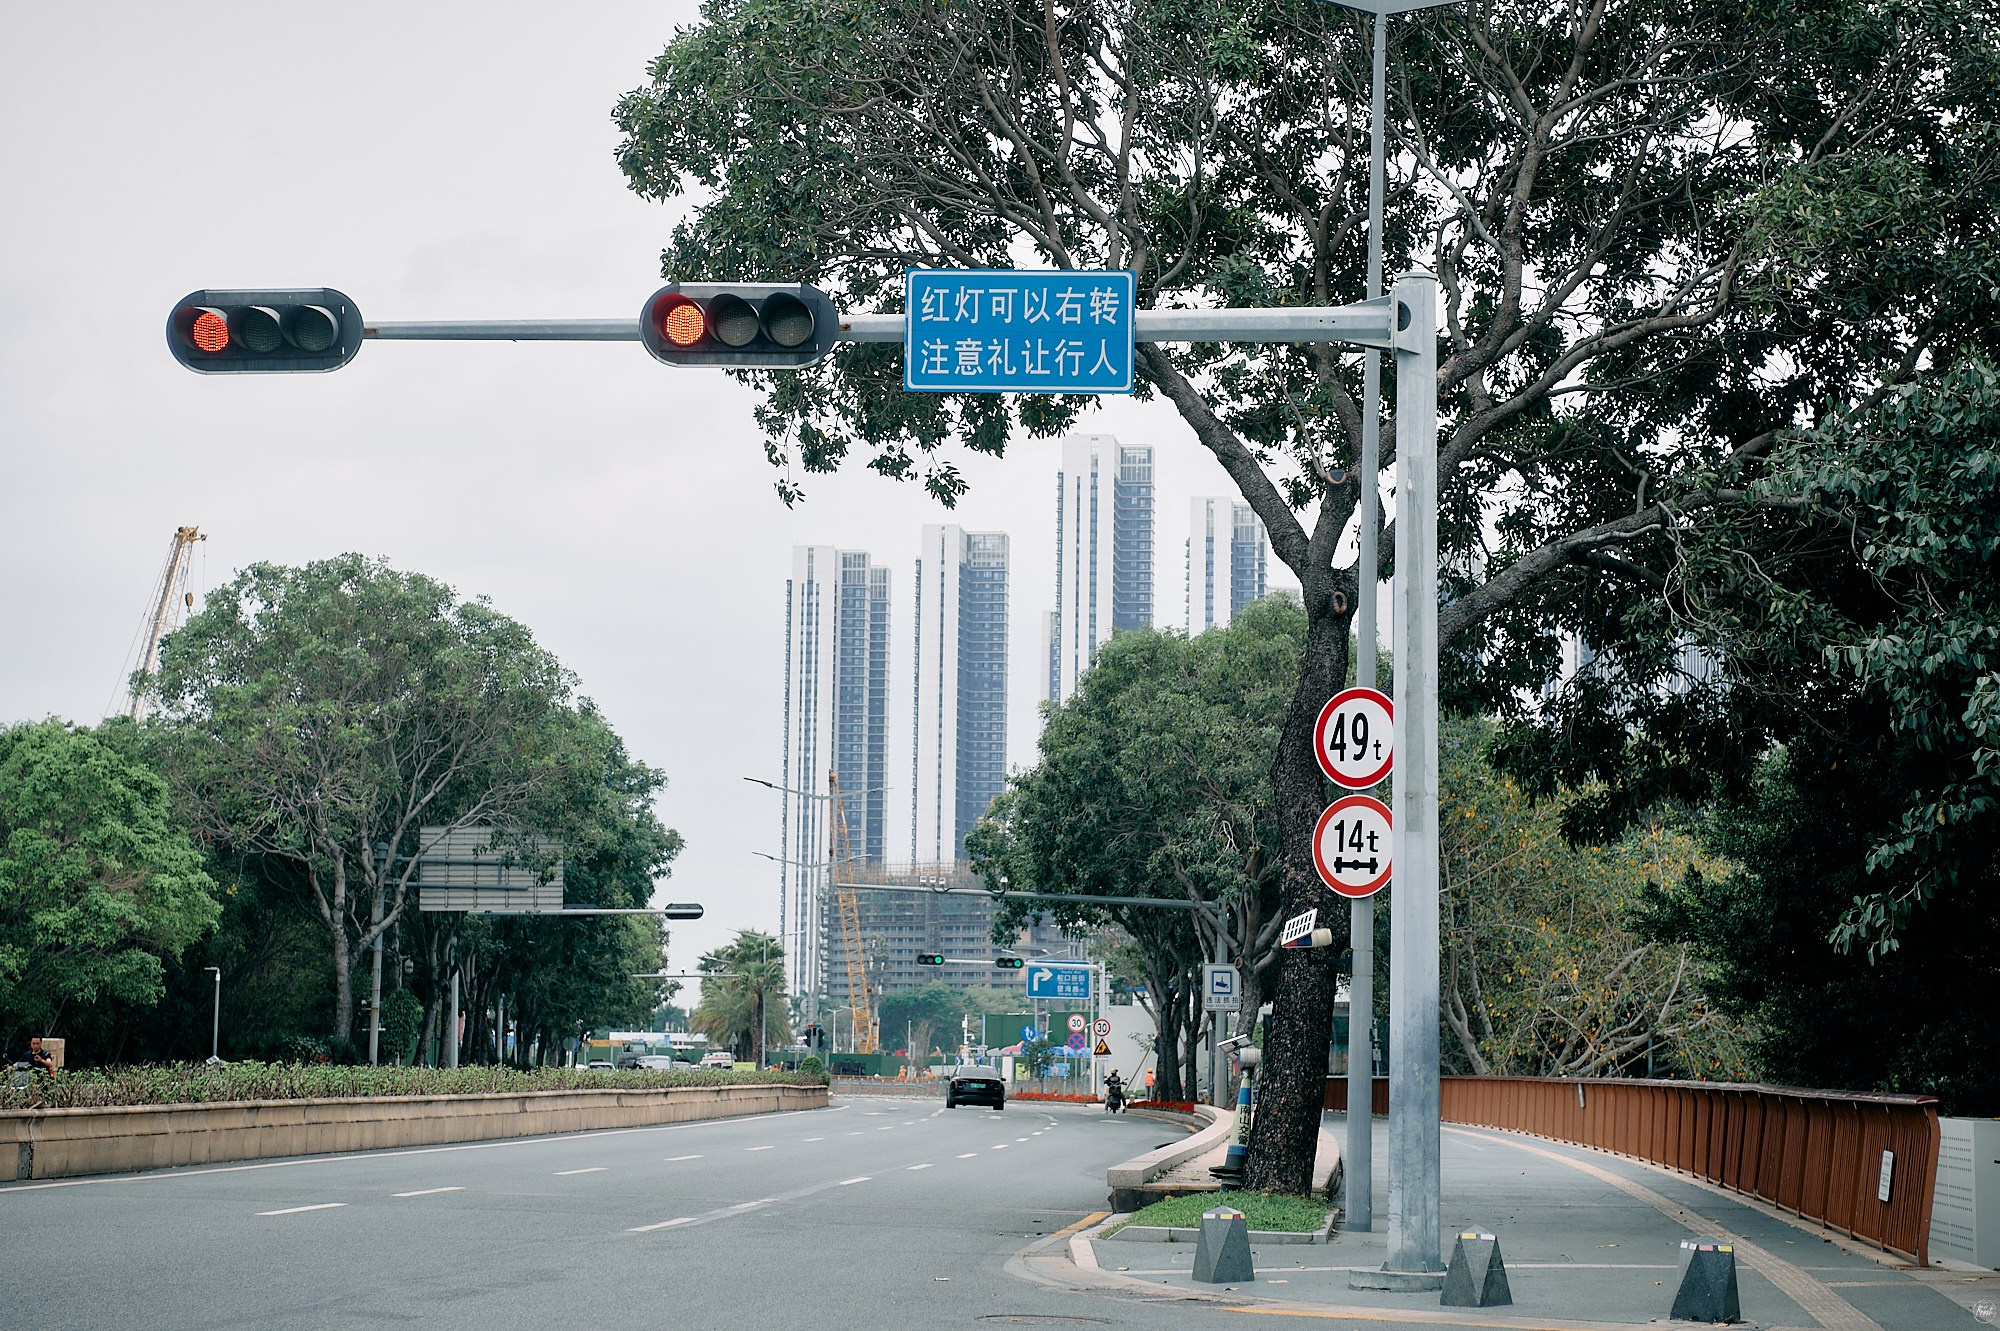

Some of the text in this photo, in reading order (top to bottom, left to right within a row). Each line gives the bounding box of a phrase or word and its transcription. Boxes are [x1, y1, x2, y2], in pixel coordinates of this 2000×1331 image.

[921, 286, 1120, 325] 红灯可以右转
[920, 337, 1118, 377] 注意礼让行人
[1329, 712, 1382, 762] 49t
[1333, 819, 1379, 853] 14t
[1072, 1019, 1082, 1028] 30
[1097, 1023, 1107, 1033] 30
